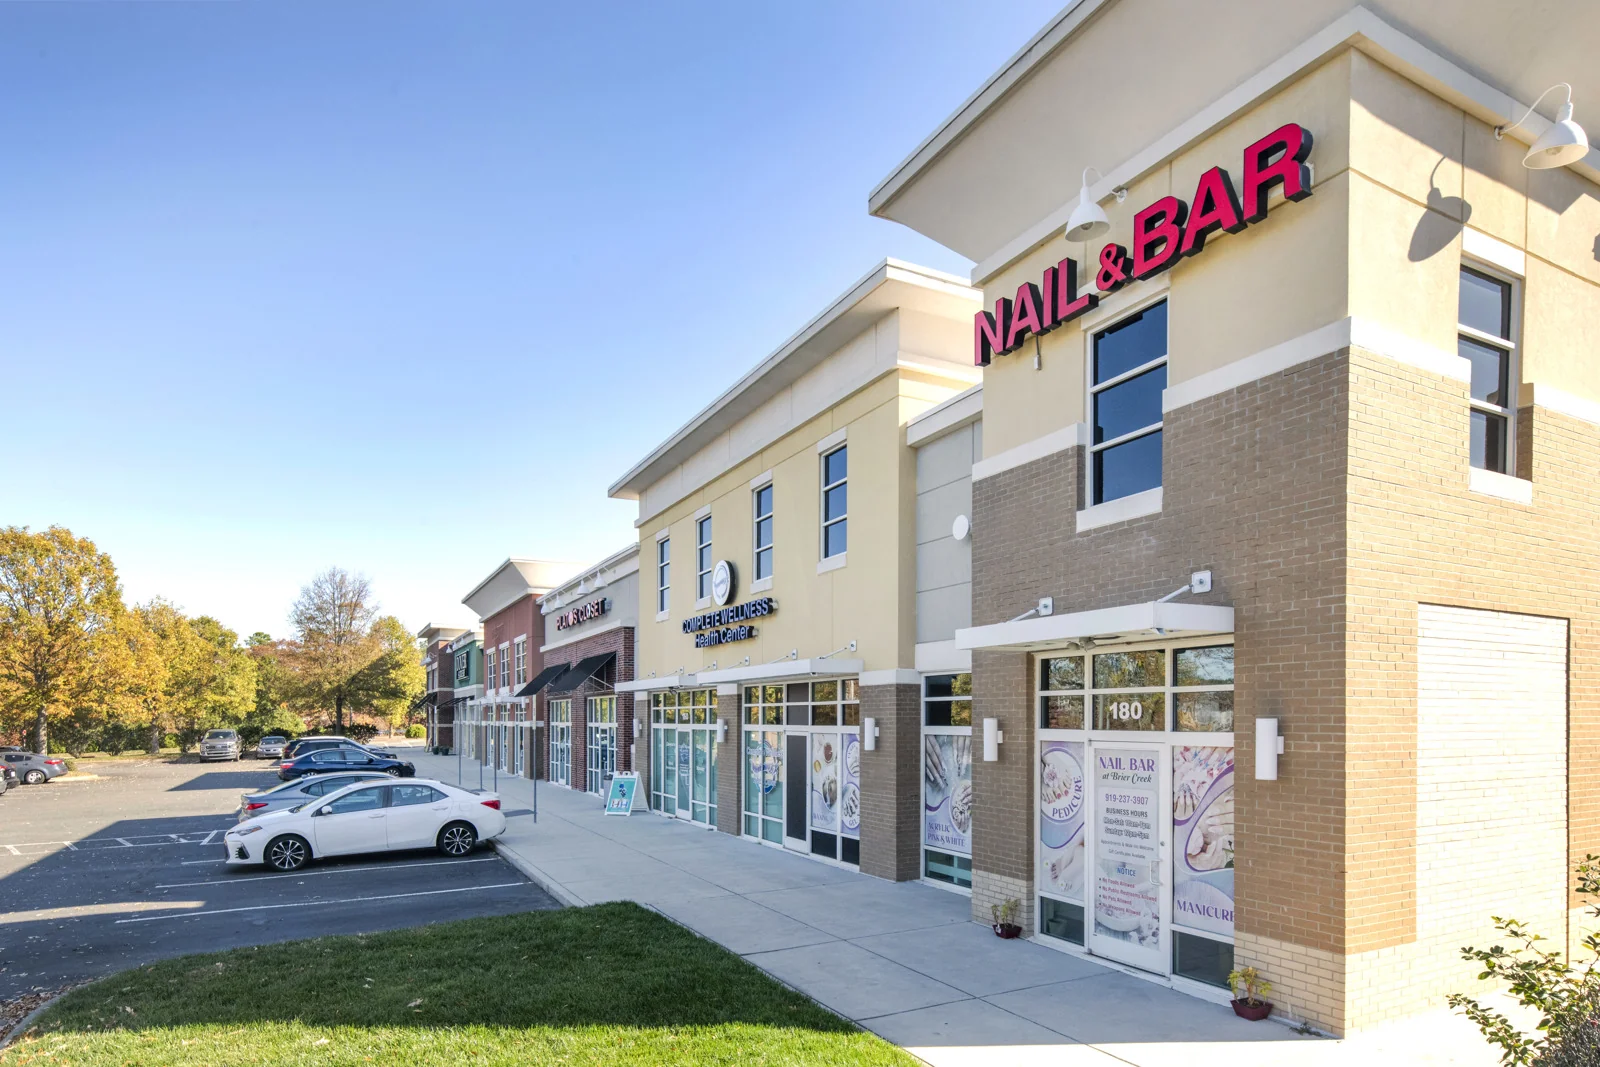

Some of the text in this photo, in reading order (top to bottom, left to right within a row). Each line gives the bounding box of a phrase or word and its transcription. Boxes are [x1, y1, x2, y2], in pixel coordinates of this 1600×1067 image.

[975, 122, 1313, 367] NAIL & BAR
[579, 598, 606, 622] CLOSET
[682, 597, 773, 634] COMPLETE WELLNESS
[695, 625, 753, 648] Health Center
[1109, 702, 1143, 720] 180
[1099, 756, 1155, 772] NAIL BAR
[1110, 771, 1131, 781] Brier
[1131, 773, 1152, 785] Creek
[1052, 775, 1082, 819] PEDICURE
[1105, 793, 1149, 806] 919-237-3907
[1105, 807, 1148, 818] BUSINESS HOURS
[946, 835, 966, 847] WHITE
[1116, 867, 1136, 877] NOTICE
[1177, 899, 1235, 922] MANICURE
